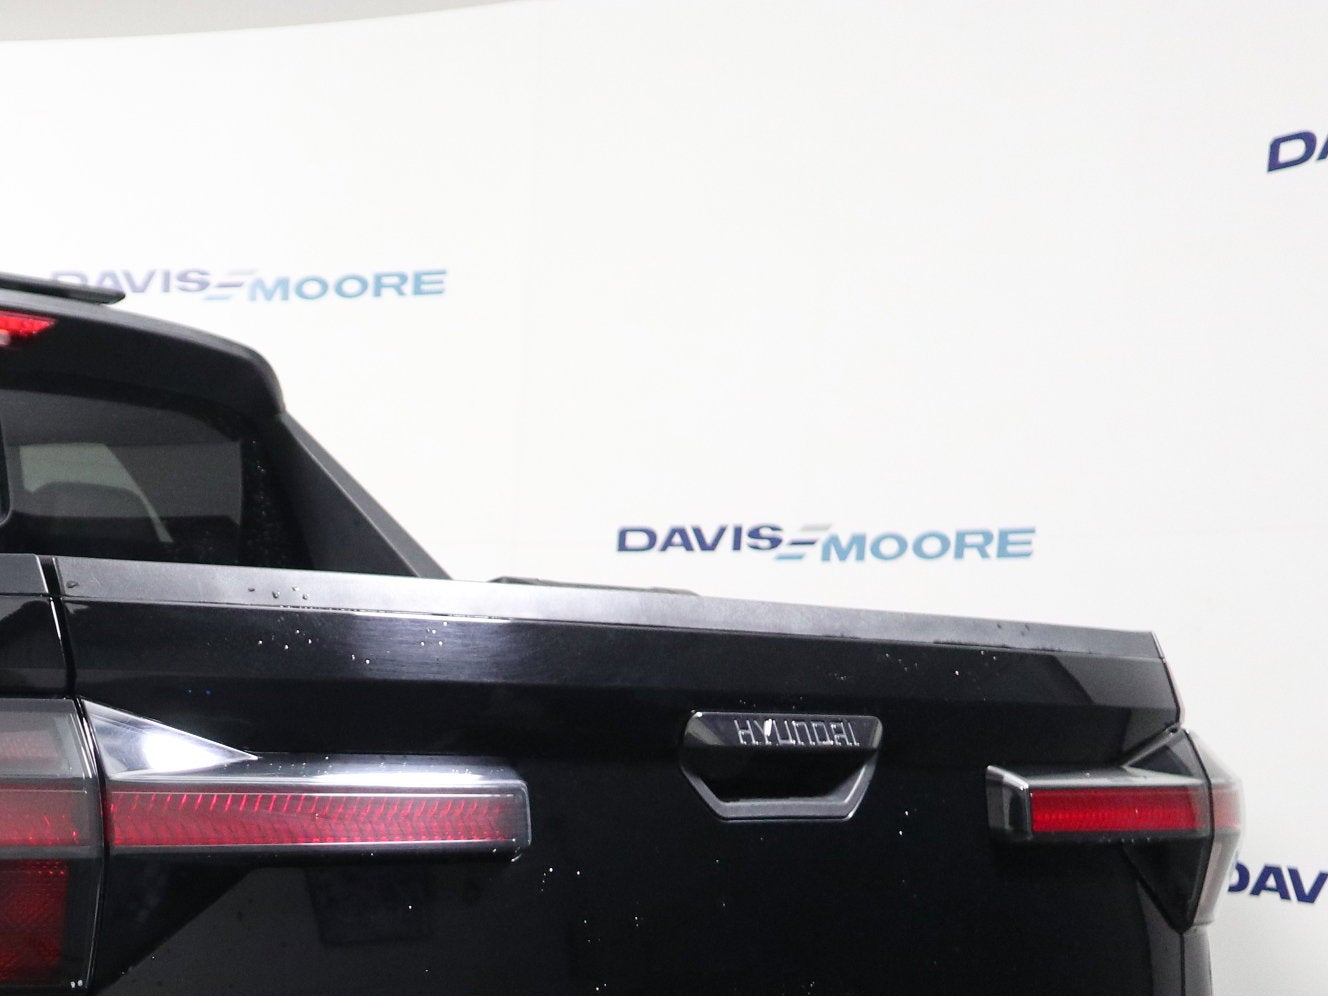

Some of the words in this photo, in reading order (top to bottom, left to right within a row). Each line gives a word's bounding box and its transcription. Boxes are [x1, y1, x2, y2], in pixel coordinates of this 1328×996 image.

[49, 267, 211, 294] DAVIS
[249, 269, 448, 302] MOORE
[616, 523, 783, 552] DAVIS
[820, 526, 1036, 562] MOORE
[733, 718, 860, 746] HYUNDAI
